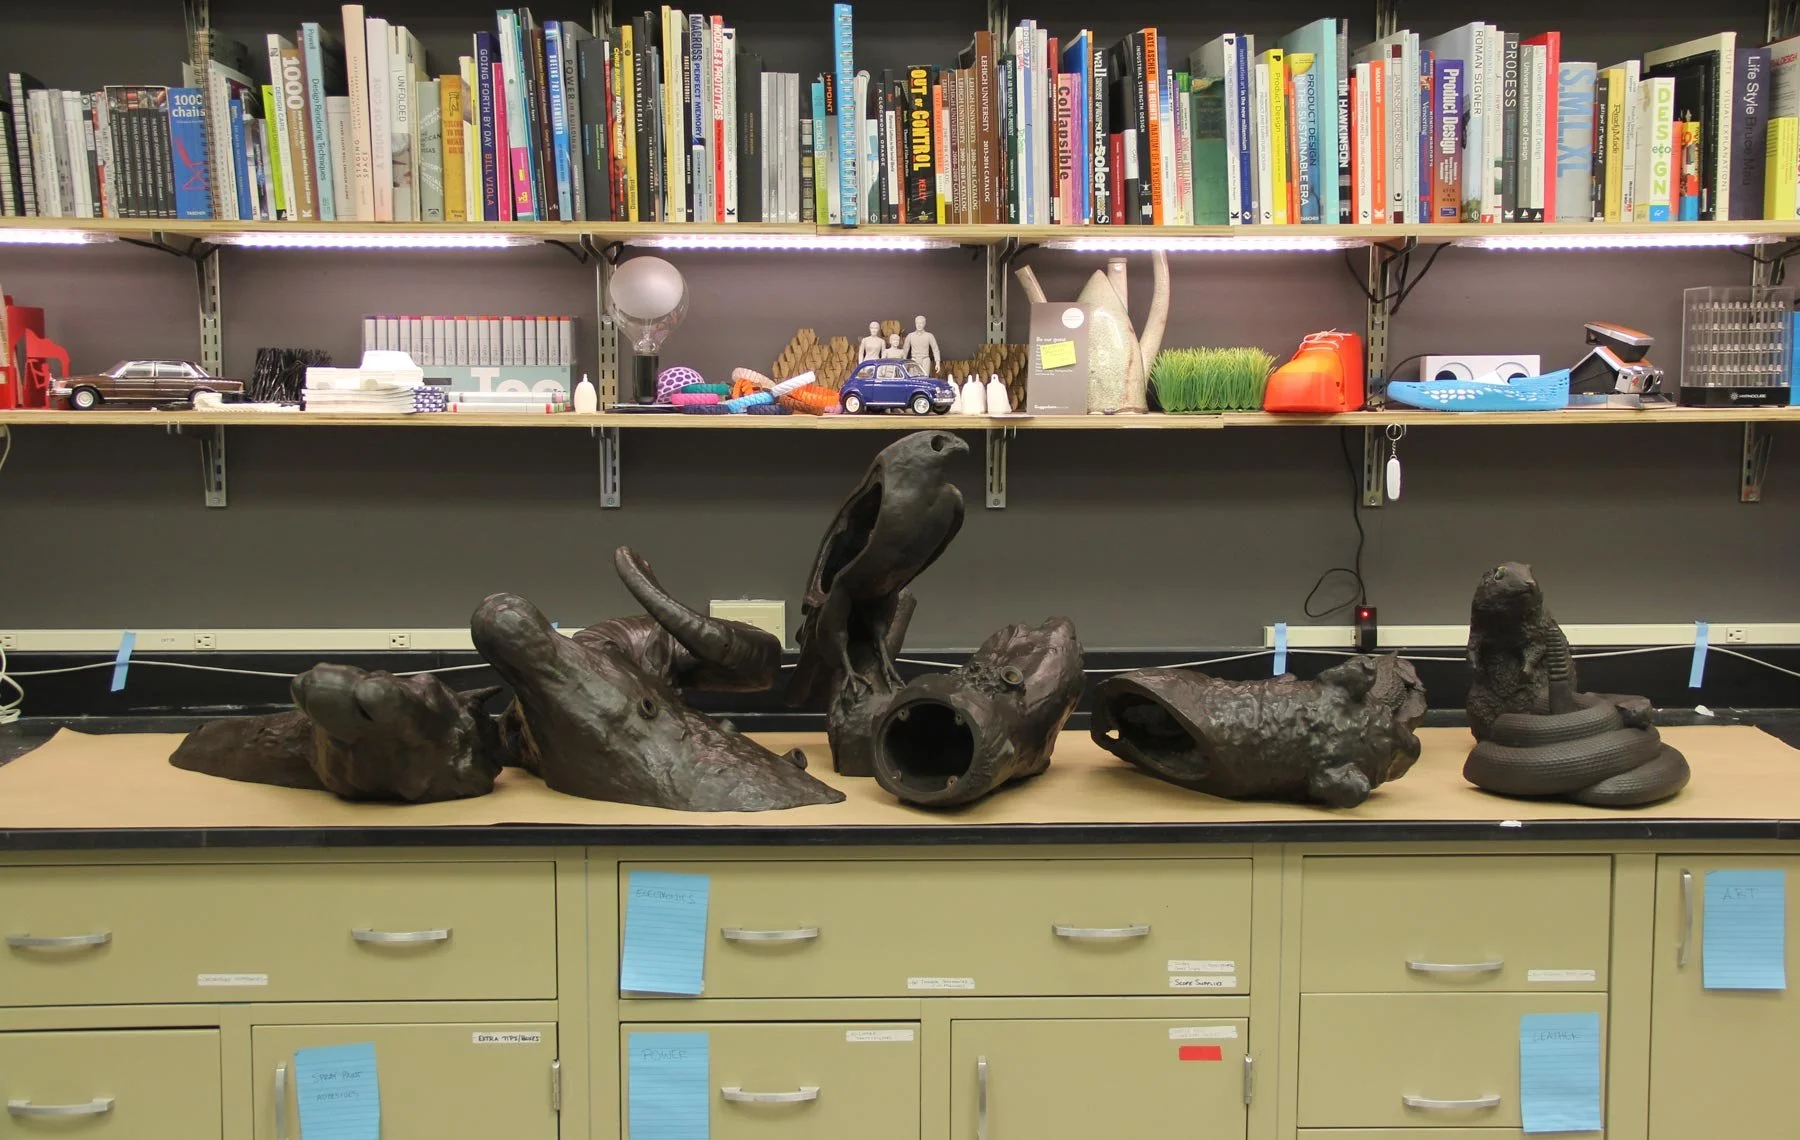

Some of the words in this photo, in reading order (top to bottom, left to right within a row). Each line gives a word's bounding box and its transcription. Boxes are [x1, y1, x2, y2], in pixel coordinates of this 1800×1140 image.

[690, 16, 702, 61] MACROSS
[713, 24, 723, 58] MODELS
[1147, 32, 1155, 49] KATE
[1474, 30, 1483, 68] ROMAN
[480, 49, 489, 79] GOING
[549, 55, 560, 78] BOEING
[1147, 49, 1156, 74] ASCHER
[1505, 41, 1517, 107] PROCESS
[1747, 56, 1760, 79] Life
[282, 56, 304, 110] 1000
[311, 78, 321, 104] Design
[565, 59, 575, 99] POWER
[911, 70, 928, 94] OUT
[1148, 80, 1156, 92] THE
[1338, 78, 1347, 96] TIM
[1394, 73, 1402, 111] JAPANESE
[1442, 68, 1459, 114] Product
[1523, 62, 1531, 94] Universal
[1536, 63, 1544, 92] Universal
[275, 87, 283, 112] DESIGN
[396, 75, 407, 122] UNFOLDED
[481, 83, 490, 113] FORTH
[568, 102, 574, 110] IN
[714, 66, 723, 120] PROTOTYPES
[914, 99, 923, 107] OF
[1149, 93, 1157, 120] HEIGHTS
[1298, 88, 1306, 109] THE
[1307, 74, 1316, 123] PRODUCT
[1376, 94, 1381, 103] IT
[1473, 73, 1482, 115] SIGNER
[1743, 83, 1760, 115] Style
[277, 114, 285, 131] CARS
[313, 105, 324, 140] Rendering
[483, 117, 491, 128] BY
[551, 95, 563, 135] DREAMLINER
[694, 102, 702, 136] MEMORY
[1421, 102, 1429, 135] Veneering
[1522, 96, 1530, 126] Methods
[1534, 94, 1543, 126] Principles
[484, 131, 492, 147] DAY
[816, 120, 826, 149] cradle
[912, 110, 931, 171] CONTROL
[937, 137, 942, 145] OF
[1058, 86, 1071, 180] Collapsible
[1151, 123, 1159, 151] ANATOMY
[1339, 99, 1348, 168] HAWKINSON
[1394, 113, 1403, 170] BOOKBINDING
[1440, 116, 1458, 154] Design
[1536, 128, 1542, 136] of
[1611, 104, 1621, 154] ReadyMade
[1743, 117, 1757, 154] Bruce
[1299, 111, 1308, 182] SUSTAINABLE
[1309, 127, 1317, 166] DESIGN
[1521, 137, 1529, 160] Design
[1534, 137, 1542, 159] Design
[1652, 146, 1672, 154] eco
[1721, 124, 1729, 192] EXPLANATIONS
[317, 143, 328, 181] Techniques
[485, 153, 493, 174] BILL
[1742, 159, 1755, 186] Mau
[486, 177, 494, 205] VIOLA
[918, 179, 927, 200] KELLY
[1153, 166, 1162, 205] SKYSCRAPER
[1300, 184, 1309, 206] ERA
[1722, 888, 1759, 903] ART
